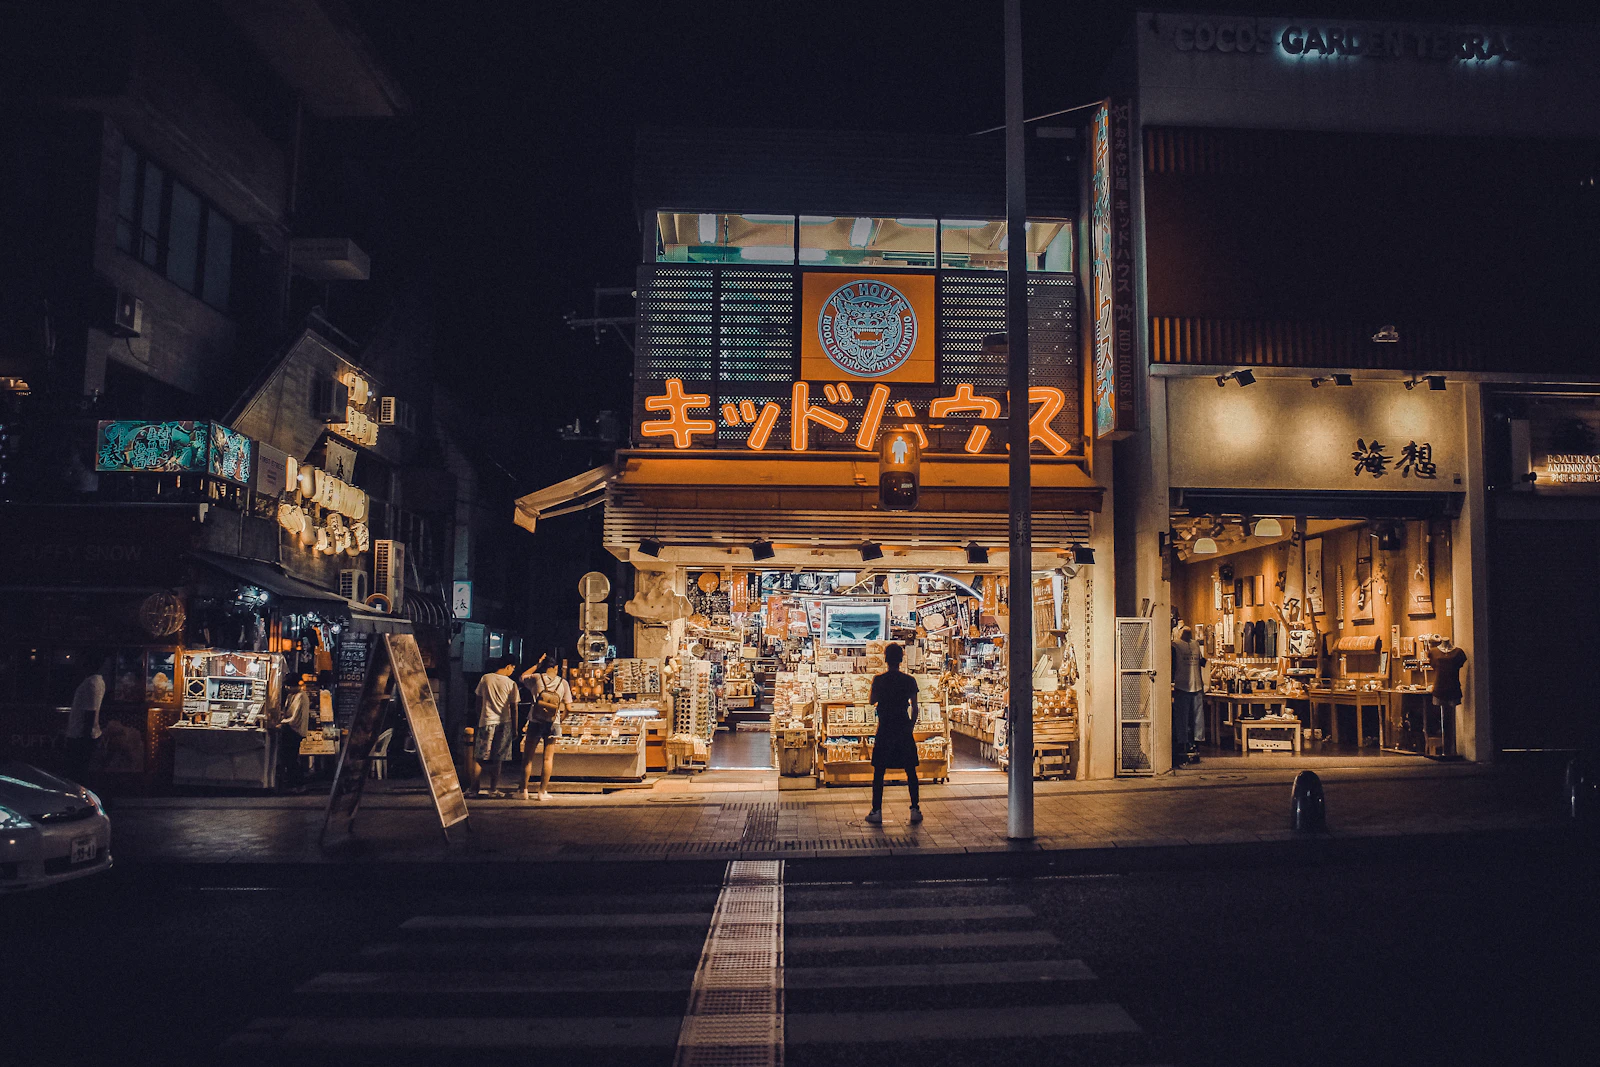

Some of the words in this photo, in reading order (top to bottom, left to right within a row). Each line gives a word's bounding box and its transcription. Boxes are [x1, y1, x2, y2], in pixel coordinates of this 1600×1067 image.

[1280, 24, 1403, 58] GARDEN
[822, 315, 834, 345] DOORI
[894, 315, 912, 359] OKINAWA
[1119, 329, 1131, 352] KID
[870, 355, 897, 371] NAHA
[1119, 356, 1132, 396] HOUSE
[640, 378, 1072, 456] キッドハウス
[1351, 438, 1437, 480] 海想
[84, 543, 143, 563] SNOW
